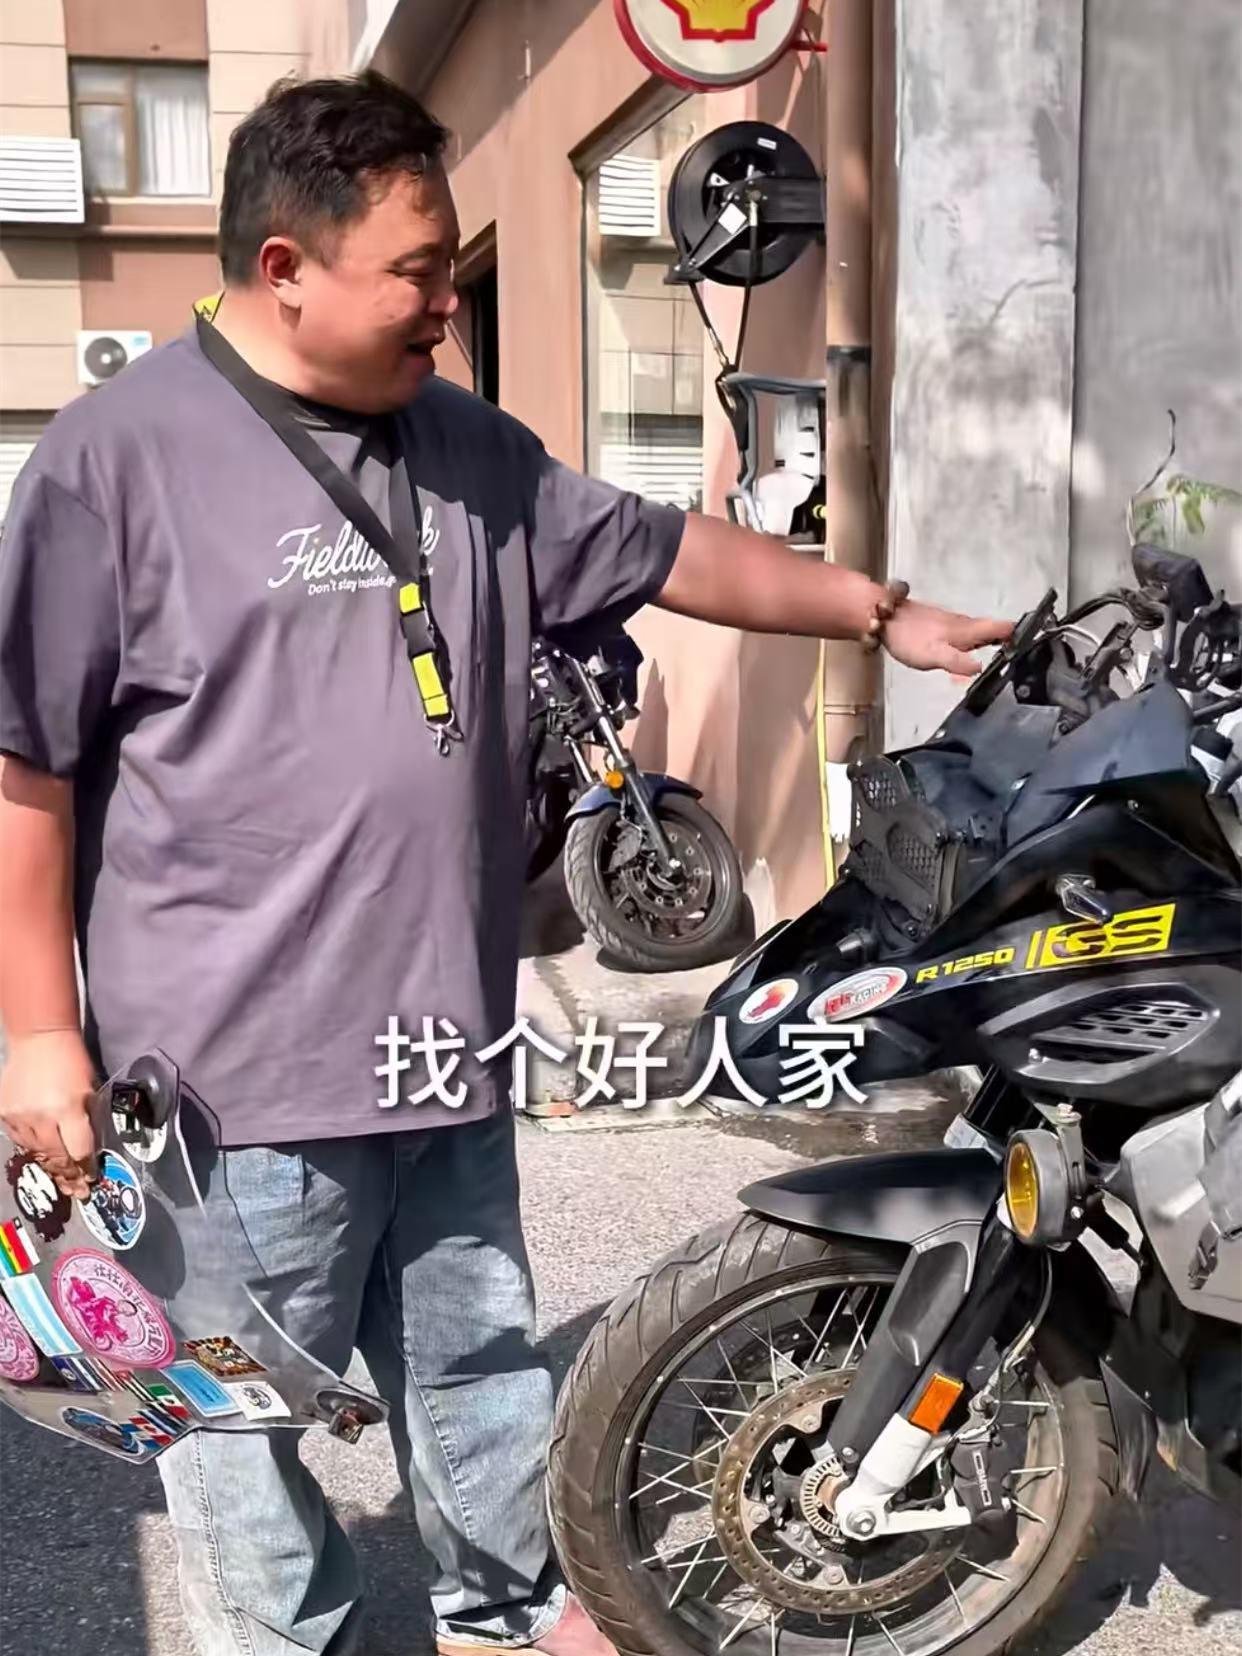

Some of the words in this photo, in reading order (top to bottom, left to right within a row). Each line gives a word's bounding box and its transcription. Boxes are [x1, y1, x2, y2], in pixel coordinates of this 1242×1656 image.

[268, 506, 440, 588] Fieldwk
[308, 578, 337, 595] Don't
[338, 577, 358, 593] stay
[1048, 911, 1168, 961] GS
